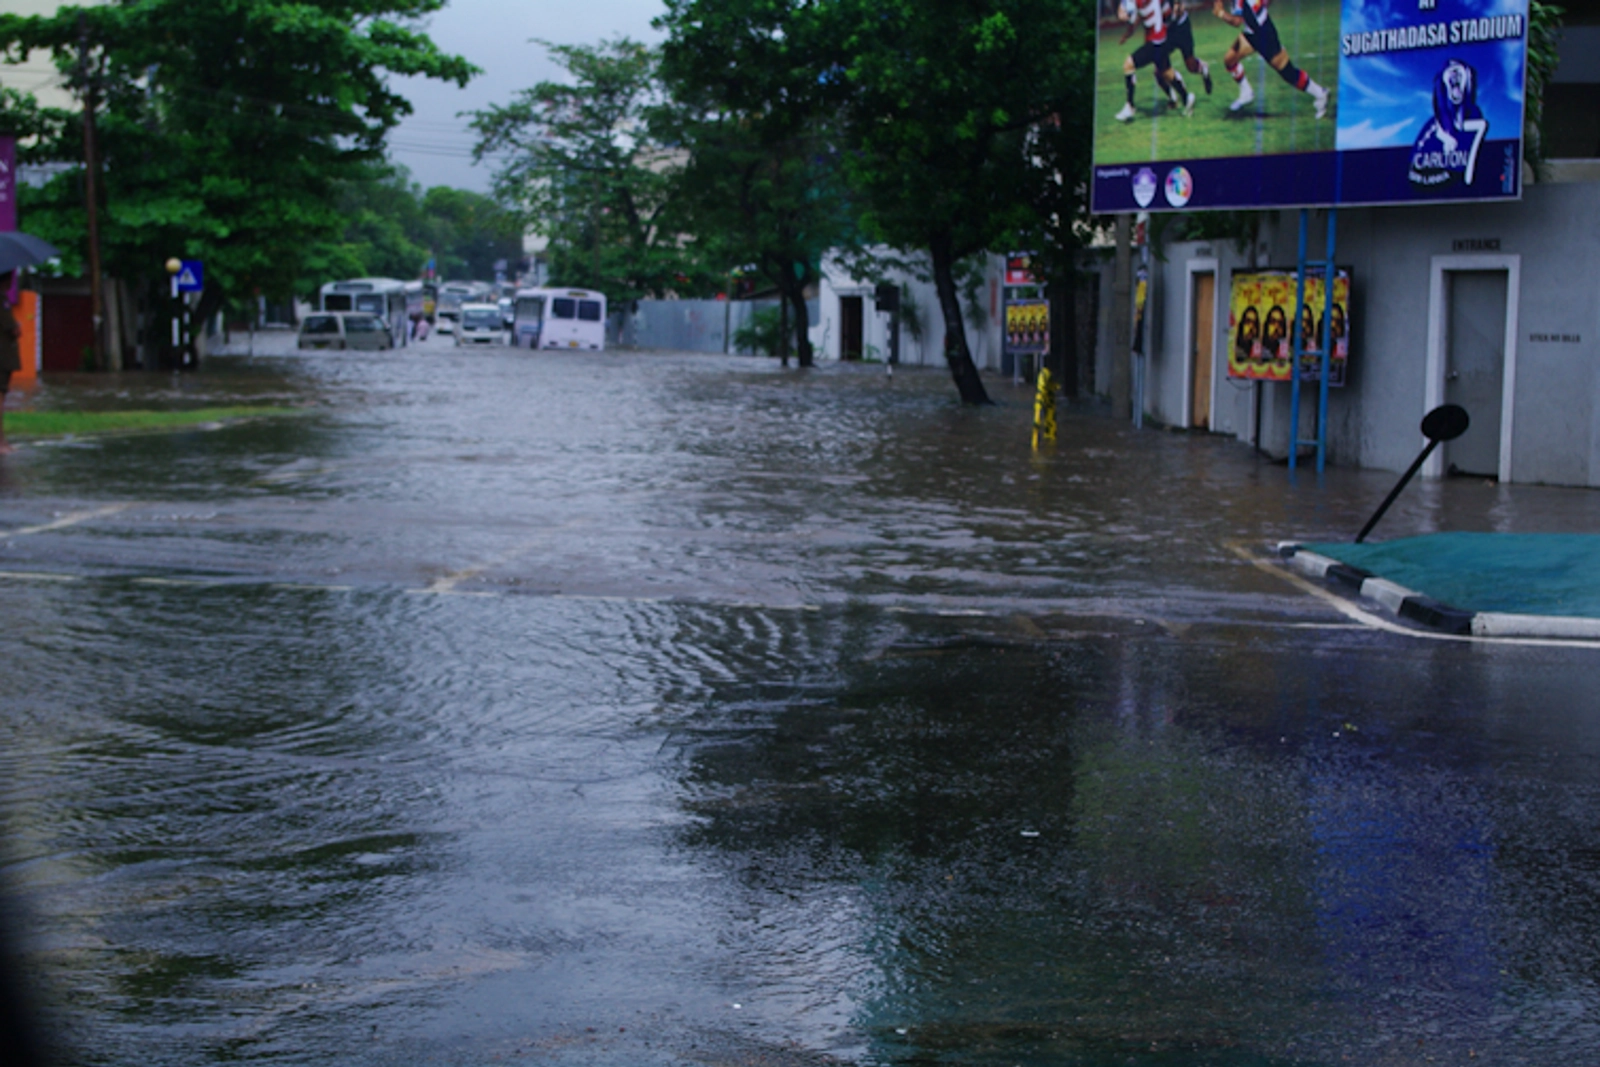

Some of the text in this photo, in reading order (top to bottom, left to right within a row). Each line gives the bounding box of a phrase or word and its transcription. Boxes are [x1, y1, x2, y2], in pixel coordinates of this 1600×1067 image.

[1342, 14, 1522, 57] SUGATHADASA STADIUM
[1414, 149, 1468, 170] CARLTON
[1463, 119, 1487, 186] 7
[1453, 238, 1501, 251] ENTRANCE
